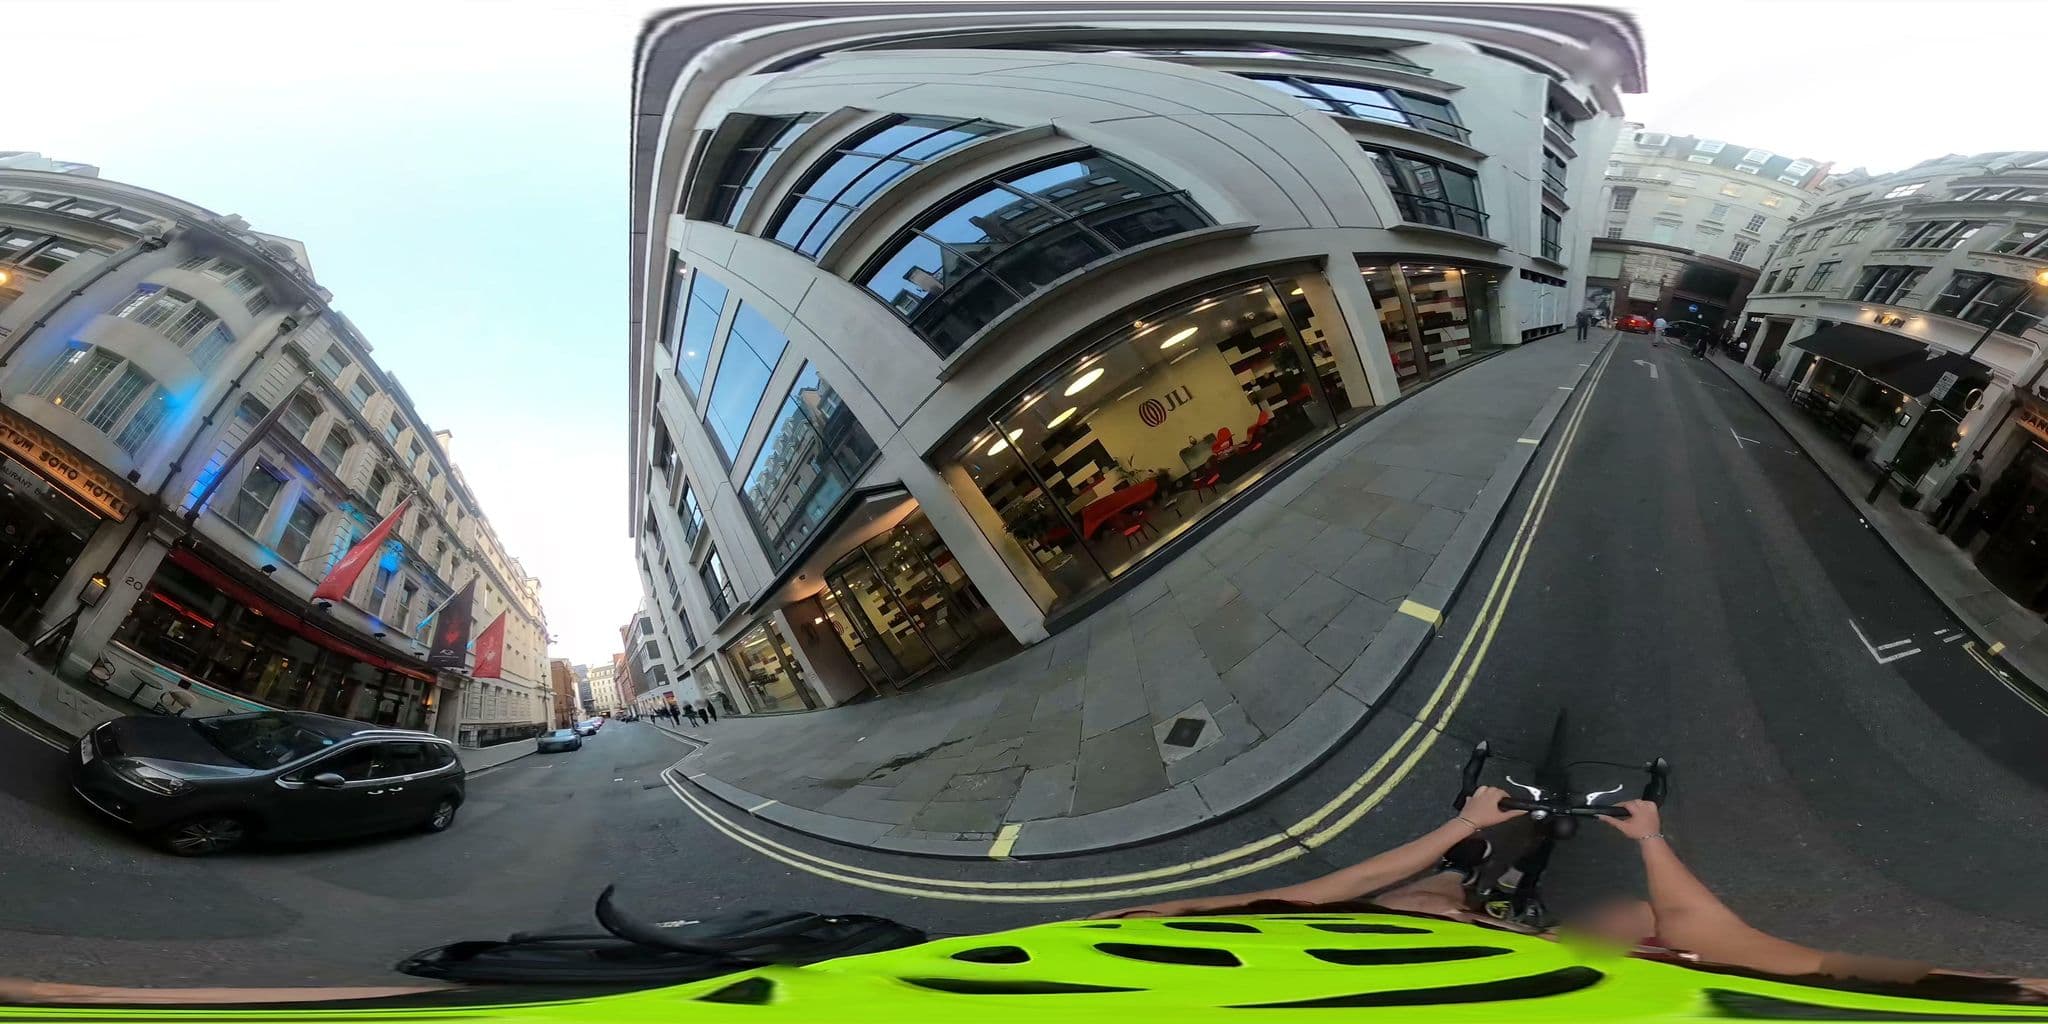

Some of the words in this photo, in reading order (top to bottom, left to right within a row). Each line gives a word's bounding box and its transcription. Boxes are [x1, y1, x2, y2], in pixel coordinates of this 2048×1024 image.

[39, 451, 79, 480] SOHO
[83, 480, 128, 517] HOTEL
[125, 576, 143, 591] 20
